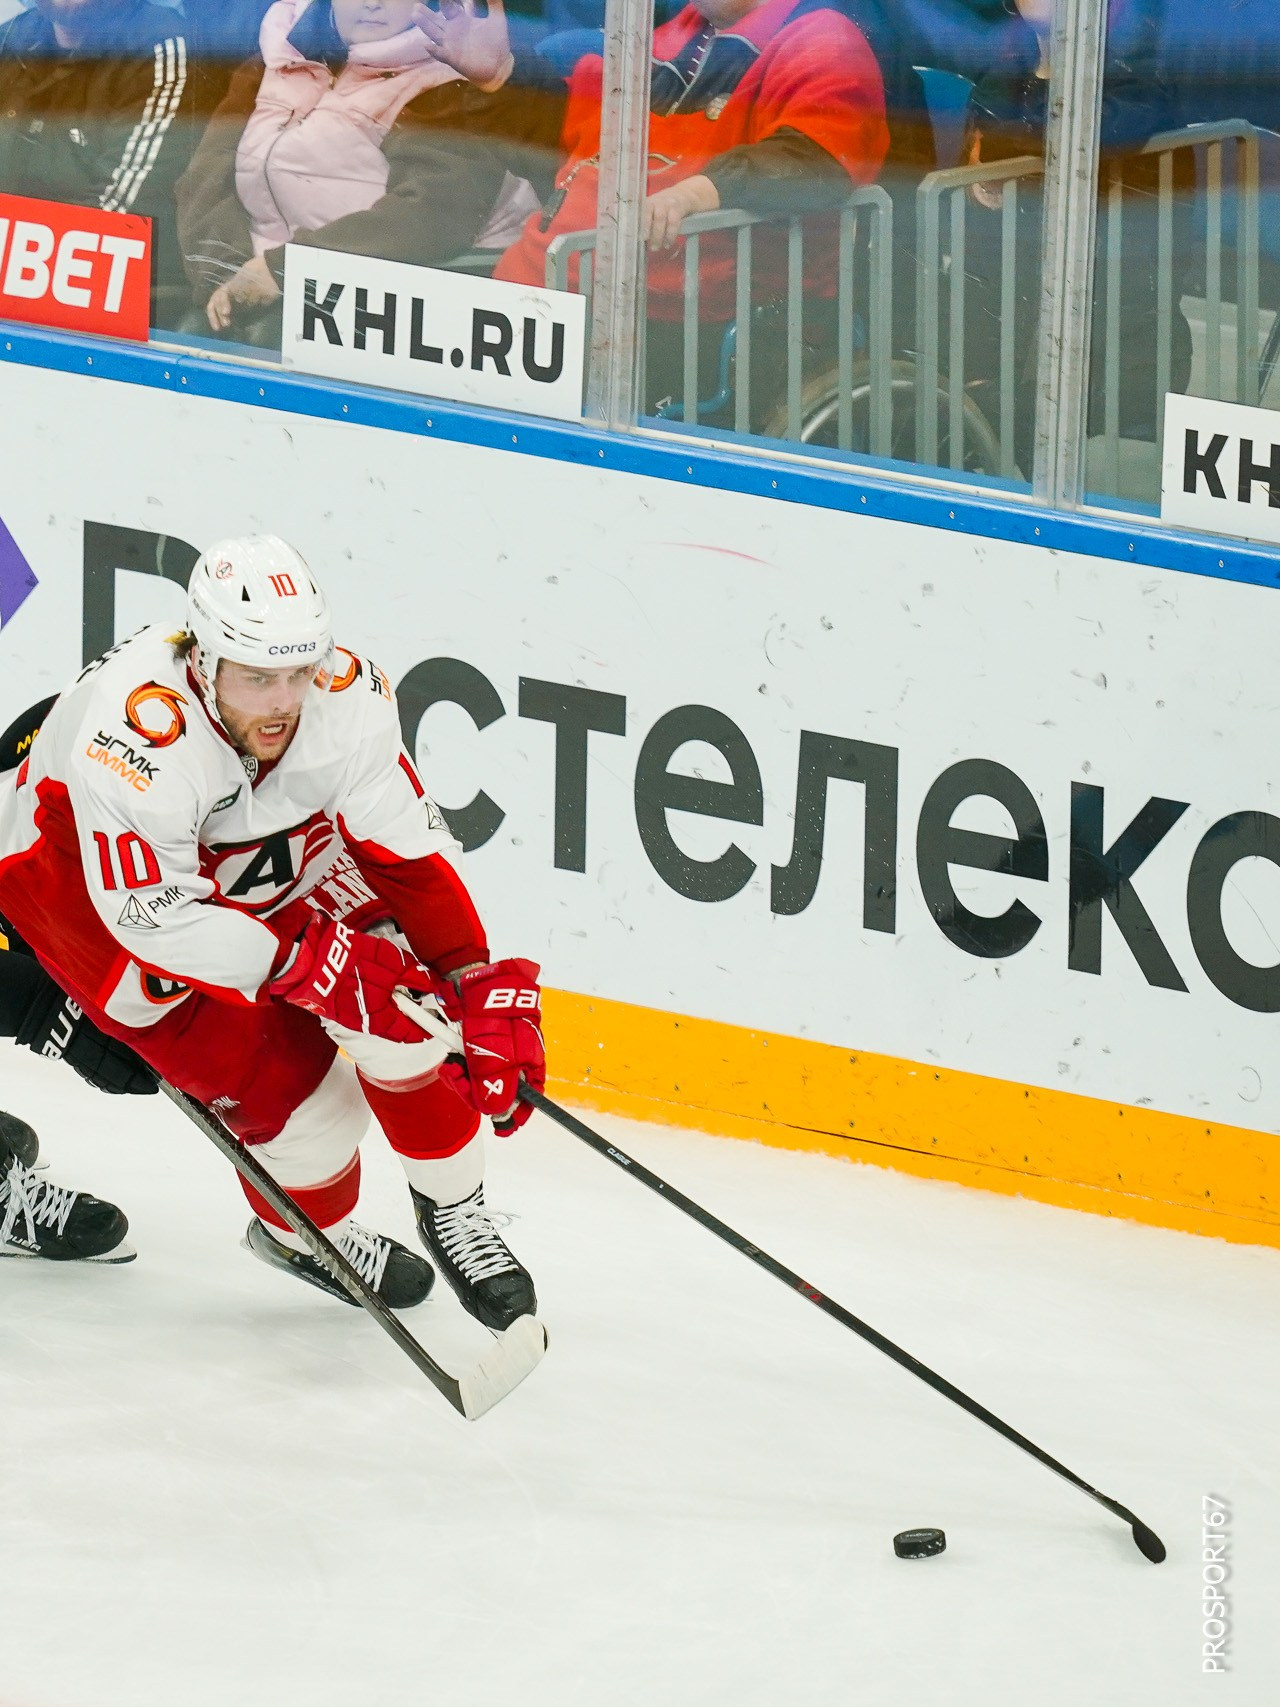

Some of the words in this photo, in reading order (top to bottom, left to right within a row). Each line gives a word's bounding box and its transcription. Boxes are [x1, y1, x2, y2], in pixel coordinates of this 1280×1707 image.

[301, 277, 566, 385] KHL.RU
[267, 573, 298, 598] 10
[268, 641, 317, 656] согаз
[85, 743, 152, 793] UMMC
[92, 730, 161, 781] УГМК
[92, 830, 163, 891] 10
